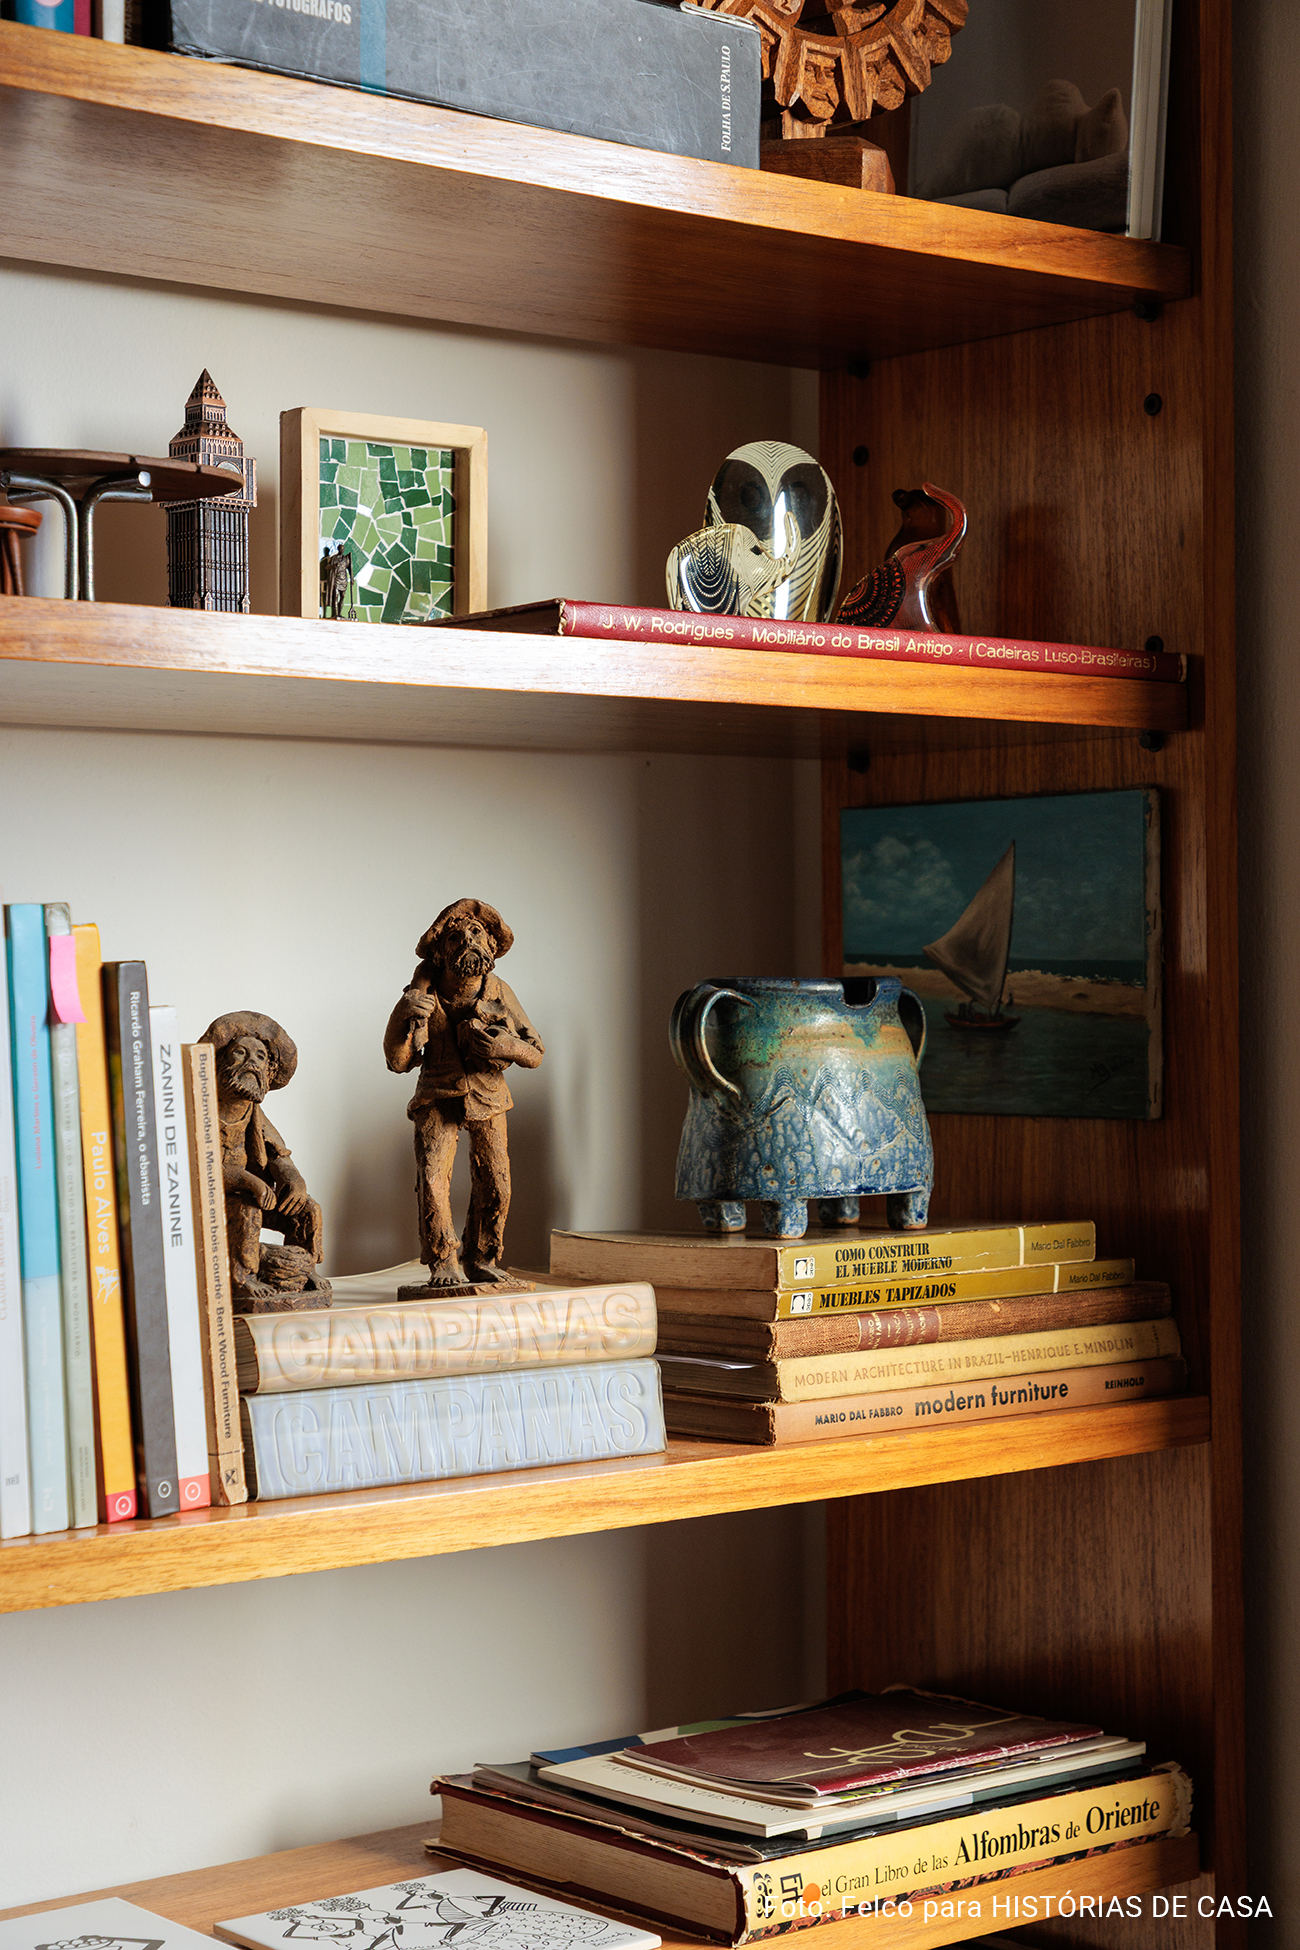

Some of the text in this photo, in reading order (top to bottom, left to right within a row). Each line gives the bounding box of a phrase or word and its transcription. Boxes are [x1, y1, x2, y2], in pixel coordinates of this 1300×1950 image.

[267, 0, 352, 25] OGRAFOS
[722, 94, 731, 111] DE
[721, 112, 732, 153] FOLHA
[603, 614, 617, 630] J.
[623, 614, 644, 632] W.
[650, 616, 734, 640] Rodrigues
[752, 627, 825, 647] Mobiliário
[831, 633, 852, 648] do
[857, 634, 900, 652] Brasil
[905, 638, 953, 658] Antigo
[968, 642, 1039, 663] (Cadeiras
[28, 1015, 37, 1047] Oliveira
[29, 1049, 38, 1060] de
[31, 1062, 39, 1092] Gerson
[130, 991, 151, 1206] Ricardo Graham Ferreira, o ebanista
[32, 1102, 41, 1135] Martins
[33, 1136, 42, 1169] Luciana
[66, 1155, 73, 1166] DA
[160, 1044, 183, 1248] ZANINI DE ZANINE
[67, 1171, 76, 1226] IDENTIDADE
[91, 1131, 110, 1254] Paulo Alves
[69, 1230, 78, 1282] BRASILEIRA
[197, 1053, 232, 1440] Bugholzmöbel Meubles en bois courbé Bent Wood Furniture
[835, 1242, 930, 1263] COMO CONSTRUIR
[1031, 1237, 1091, 1251] Mario Dal Fabbro
[836, 1255, 953, 1278] EL MUEBLE MODERNO
[1068, 1271, 1125, 1284] Mario Dal Fabbro
[71, 1286, 78, 1299] NO
[819, 1282, 957, 1309] MUEBLES TAPIZADOS
[273, 1292, 642, 1384] CAMPANAS
[794, 1371, 848, 1388] MODERN
[853, 1361, 945, 1382] ARCHITECTURE
[948, 1358, 962, 1371] IN
[815, 1376, 1146, 1425] MARIO DAL FABBRO modern furniture REINHOLD
[273, 1371, 649, 1490] CAMPANAS
[821, 1797, 1160, 1898] el Gran Libro de las Alfombras de Oriente
